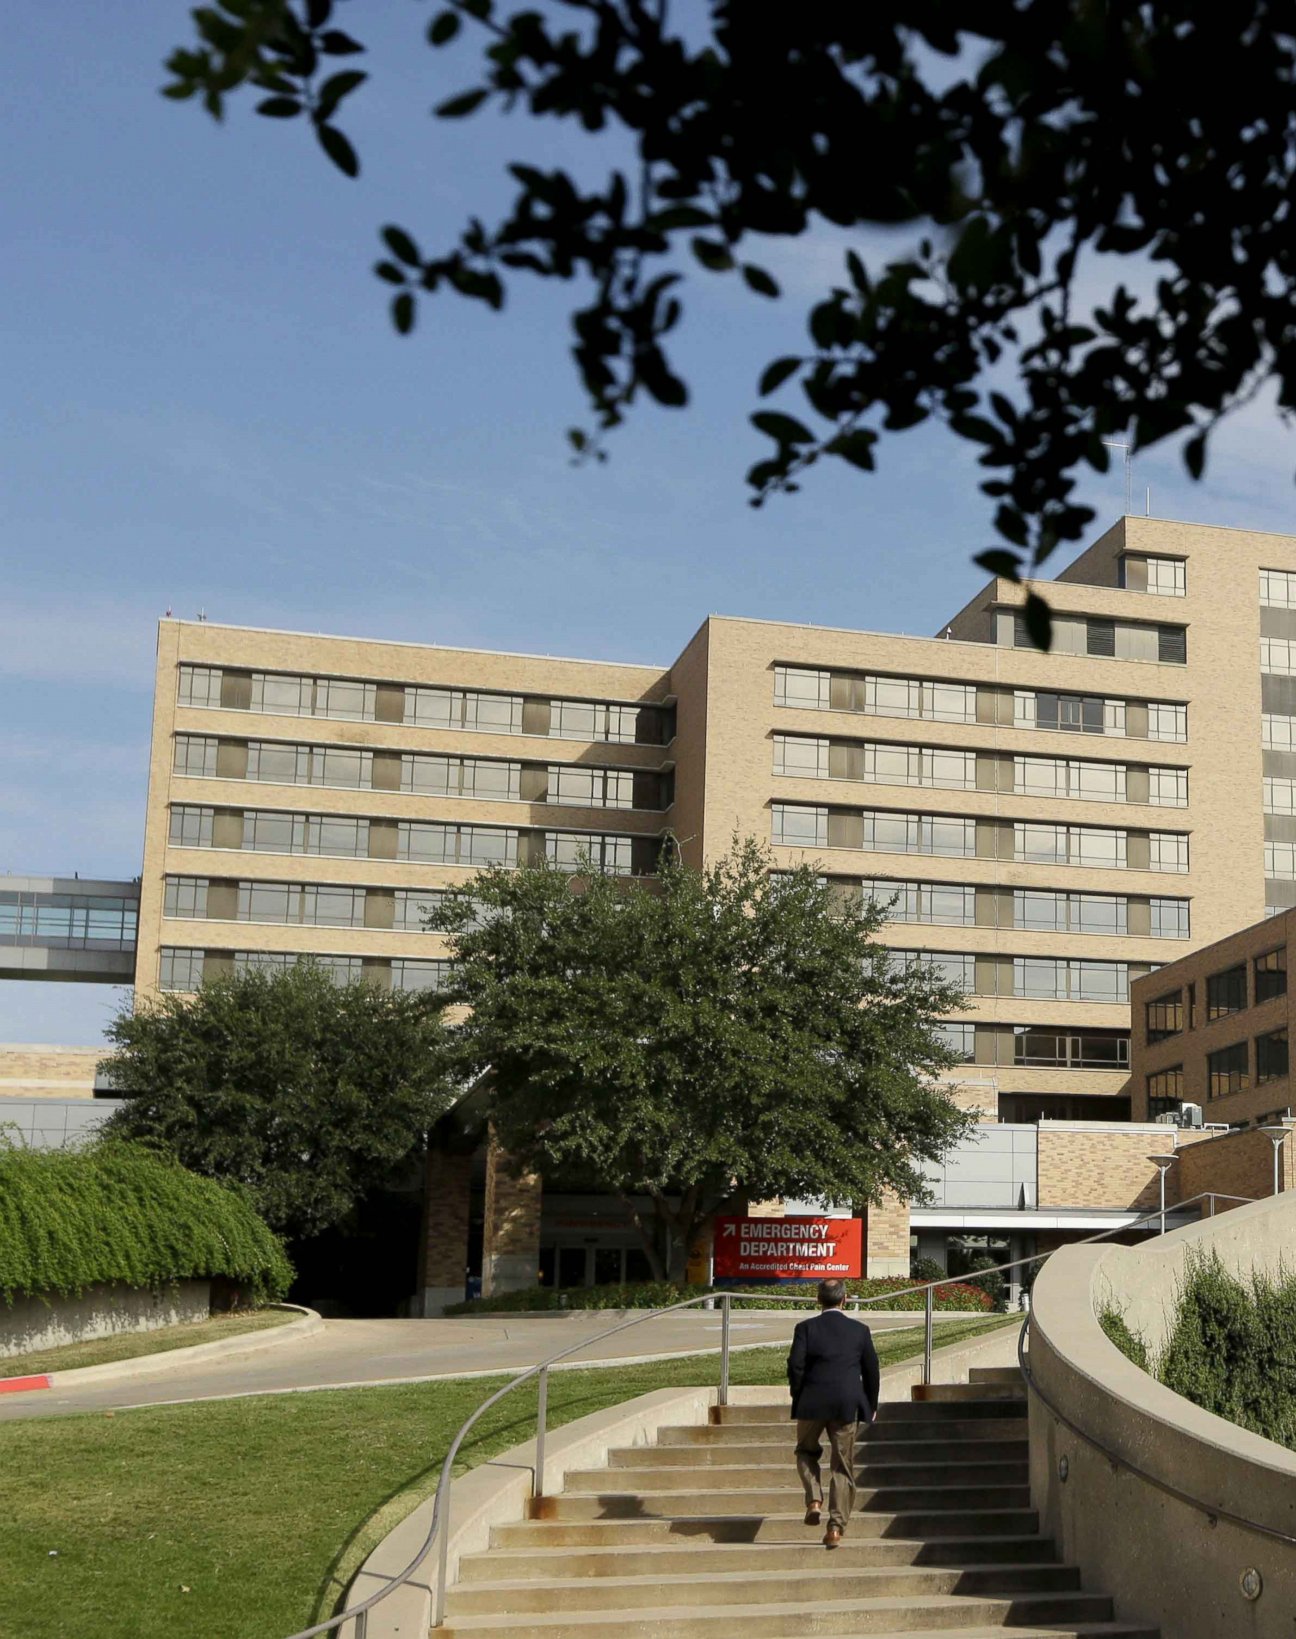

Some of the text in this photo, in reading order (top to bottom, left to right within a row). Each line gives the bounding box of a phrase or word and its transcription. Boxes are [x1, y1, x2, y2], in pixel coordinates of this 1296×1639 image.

[740, 1223, 829, 1239] EMERGENCY
[740, 1241, 836, 1257] DEPARTMENT
[740, 1262, 849, 1271] An Accredited Chest Pain Center
